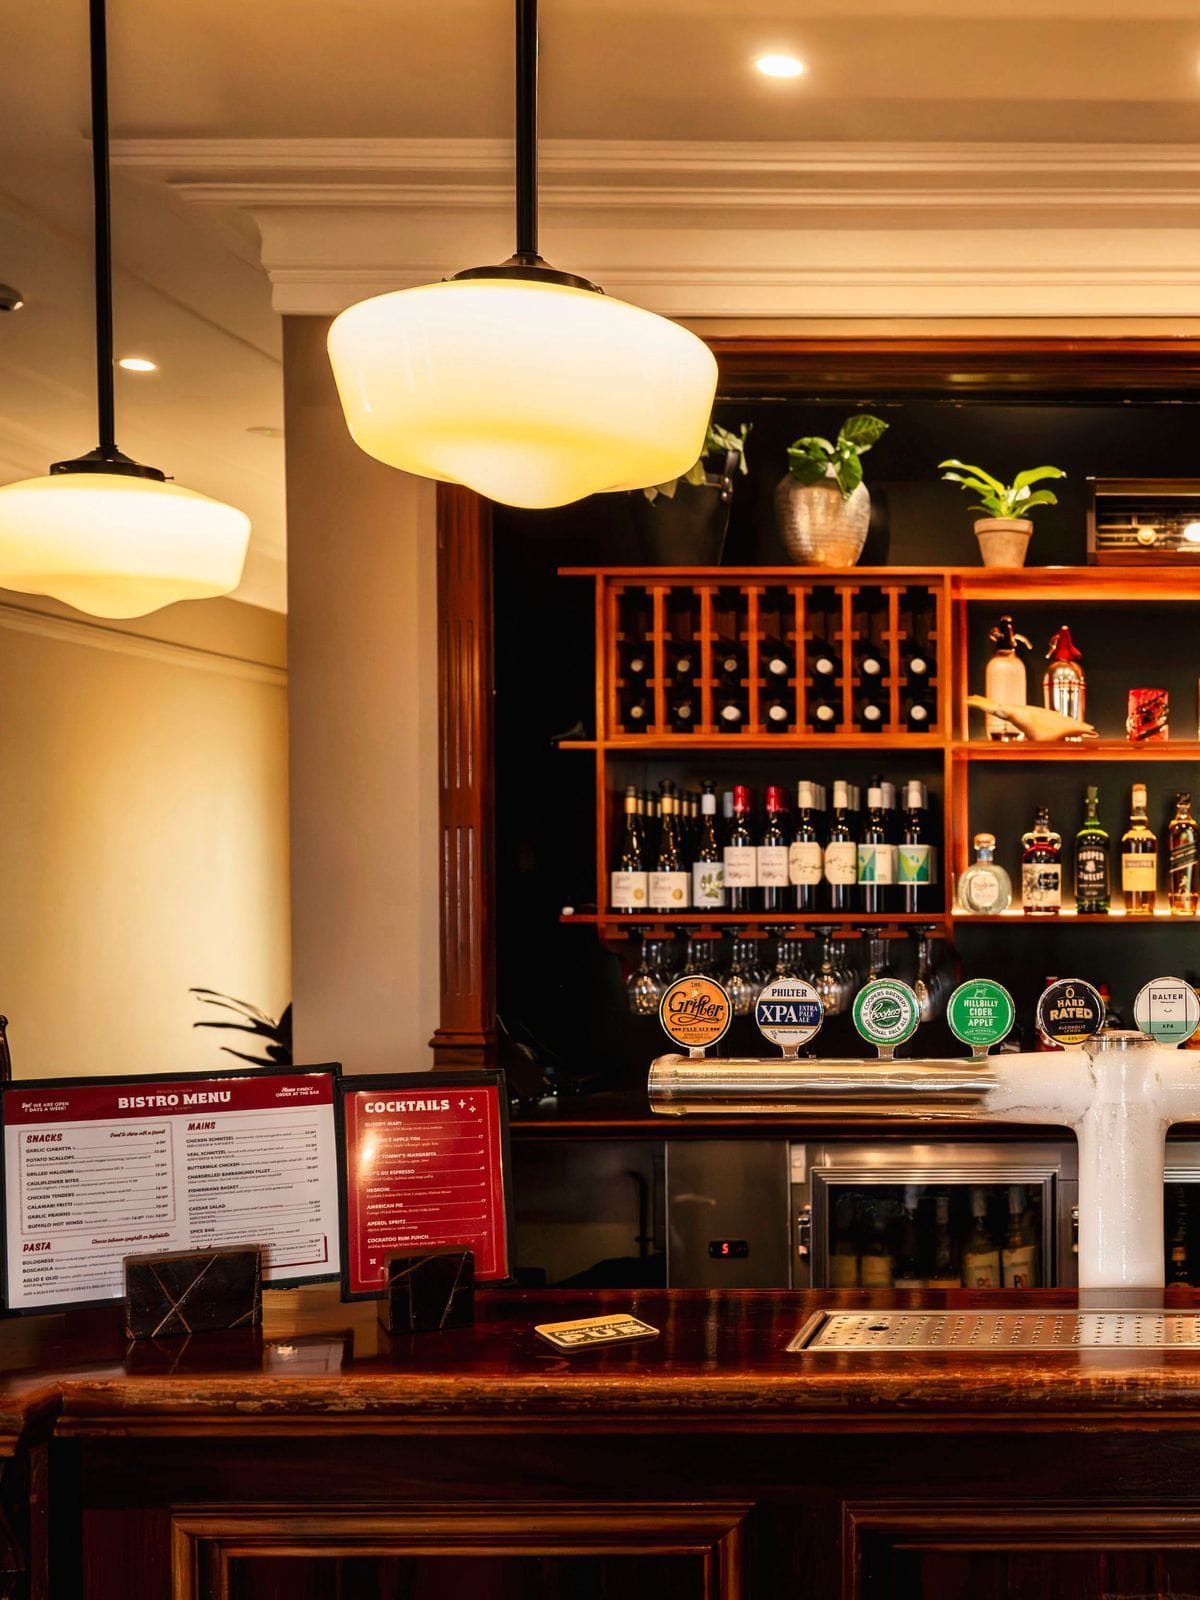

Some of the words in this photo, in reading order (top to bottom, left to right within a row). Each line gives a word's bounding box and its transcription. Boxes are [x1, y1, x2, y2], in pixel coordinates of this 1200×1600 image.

[772, 988, 808, 997] PHILTER
[668, 991, 724, 1020] Grifter
[864, 990, 884, 1010] COOPERS
[886, 990, 908, 1008] BREWERY
[964, 1000, 999, 1008] HILLBILLY
[1057, 999, 1085, 1008] HARD
[760, 1005, 798, 1022] XPA
[1050, 1008, 1094, 1021] RATED
[865, 1019, 886, 1036] ORIGINAL
[888, 1024, 901, 1035] PALE
[968, 1018, 994, 1026] APPLE
[118, 1094, 178, 1109] BISTRO
[183, 1091, 231, 1105] MENU
[364, 1099, 450, 1114] COCKTAILS
[188, 1122, 216, 1131] MAINS
[26, 1133, 63, 1144] SNACKS
[23, 1242, 51, 1252] PASTA
[559, 1325, 645, 1342] PUB
